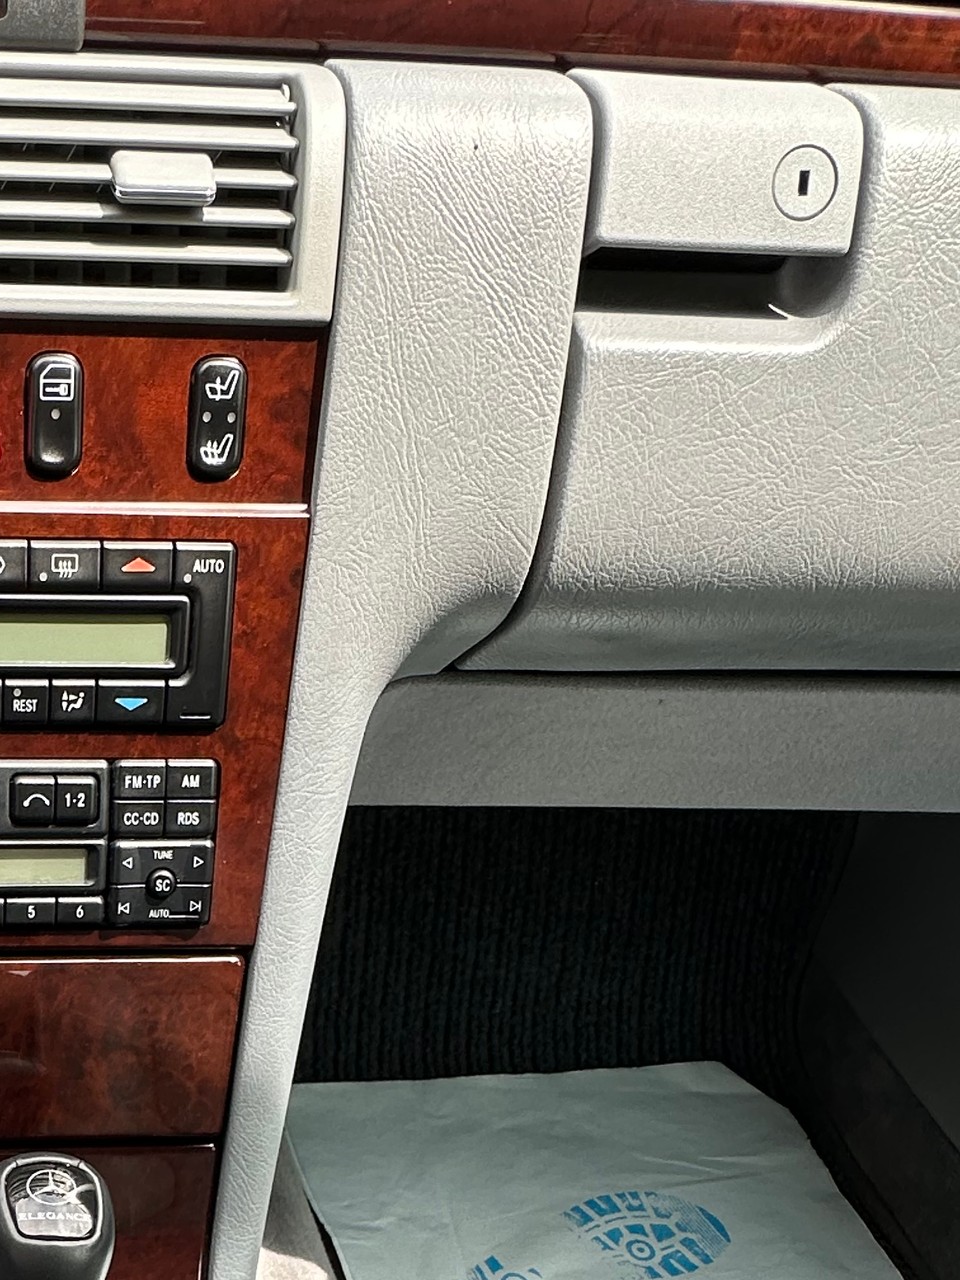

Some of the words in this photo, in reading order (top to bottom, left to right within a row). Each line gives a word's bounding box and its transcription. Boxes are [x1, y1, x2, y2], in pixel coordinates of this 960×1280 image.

[193, 558, 225, 574] AUTO
[13, 698, 38, 712] REST
[181, 775, 200, 788] AM
[177, 812, 200, 826] RDS
[153, 850, 173, 860] TUNE
[155, 878, 171, 892] SC
[27, 905, 36, 919] 5
[76, 905, 84, 918] 6
[148, 909, 170, 919] AUTO
[18, 1212, 91, 1221] ELEGANCE
